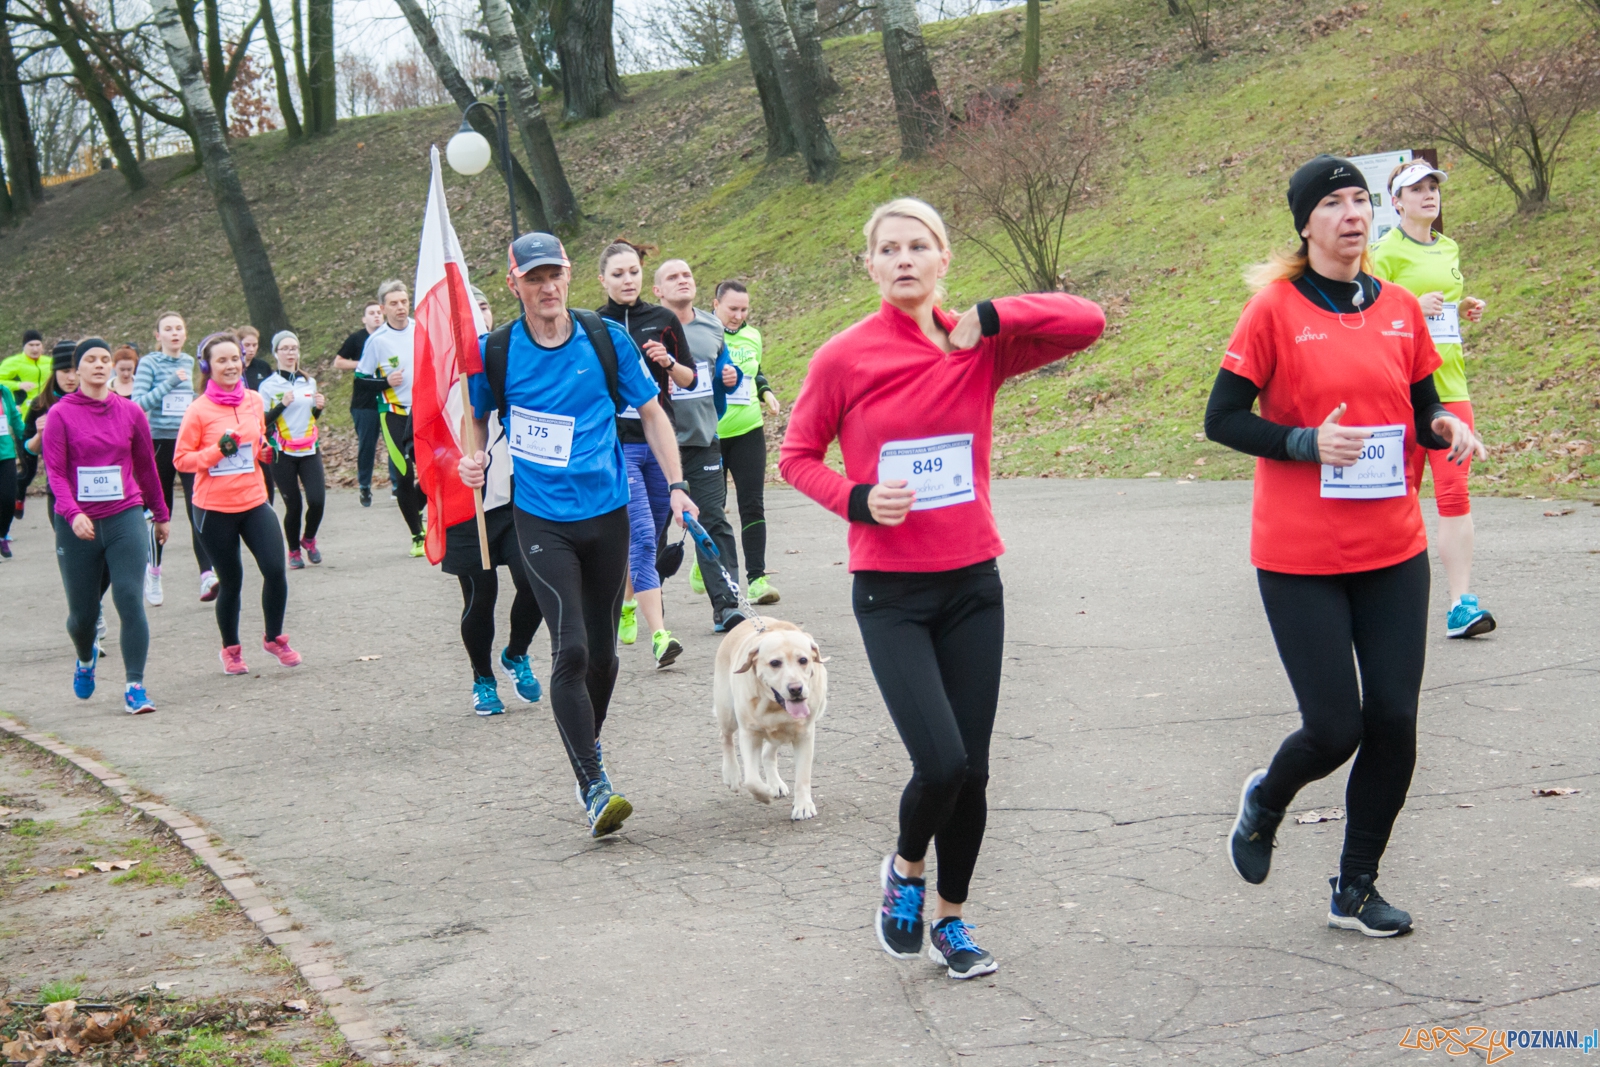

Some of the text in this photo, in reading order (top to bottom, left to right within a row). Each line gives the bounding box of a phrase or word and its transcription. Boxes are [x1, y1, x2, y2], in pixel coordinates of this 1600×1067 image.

[1295, 326, 1328, 345] parkrun
[527, 425, 548, 438] 175
[912, 457, 943, 475] 849
[1358, 465, 1385, 480] parkrun
[93, 476, 109, 485] 601
